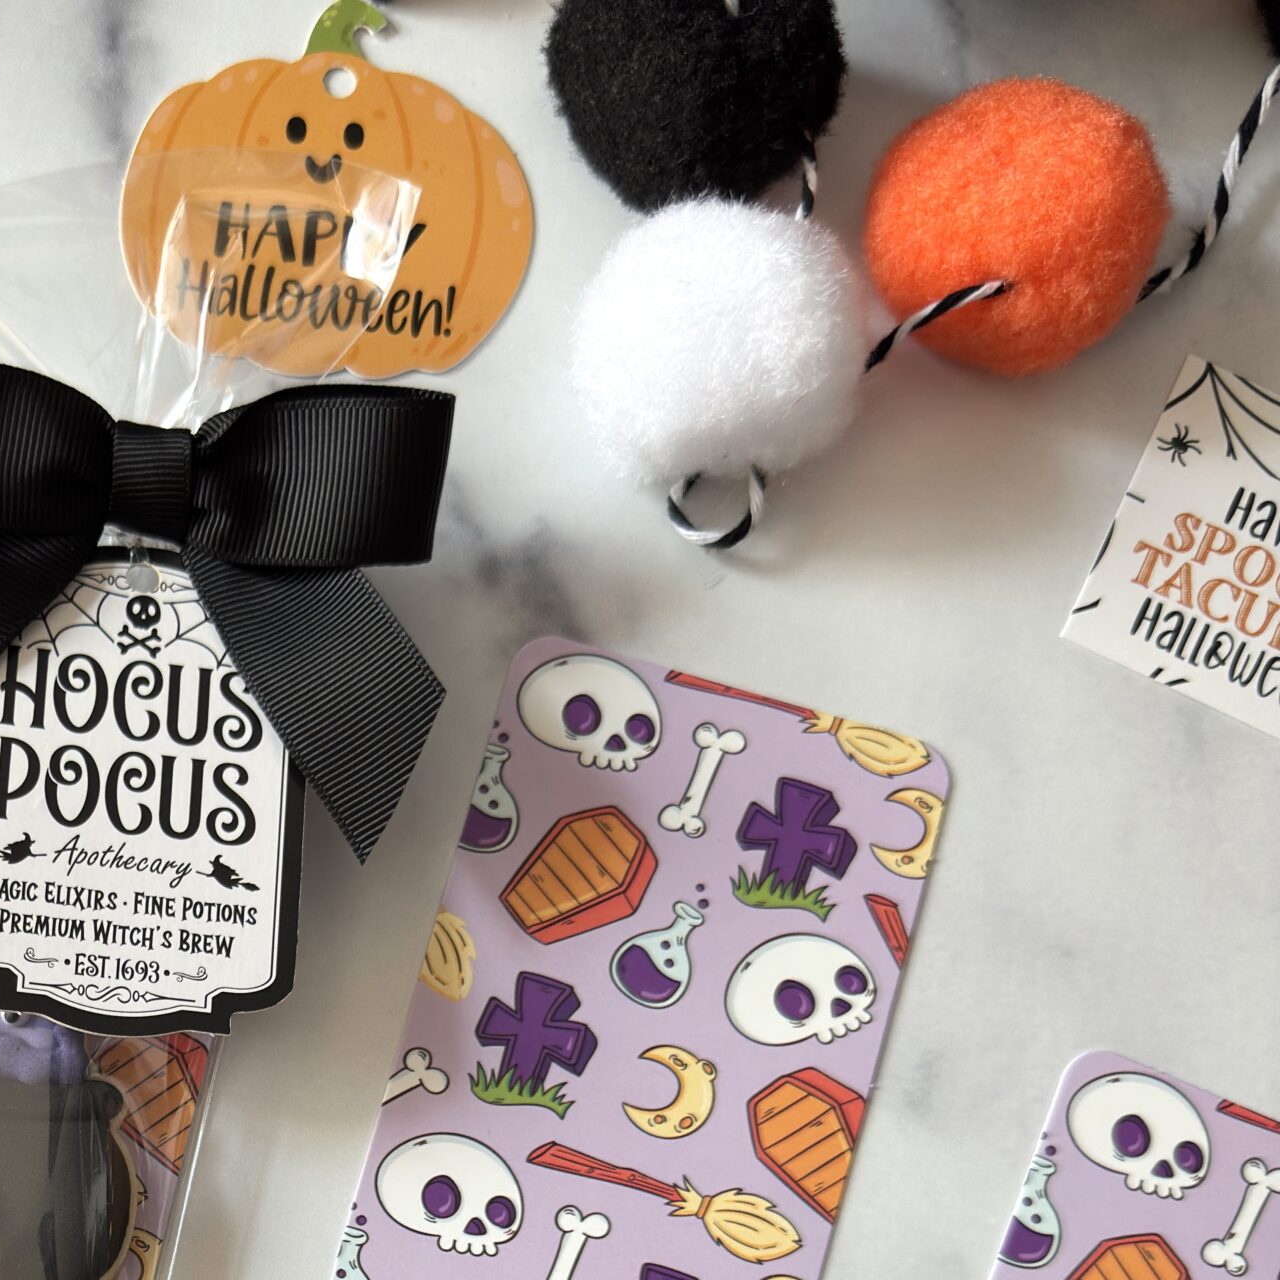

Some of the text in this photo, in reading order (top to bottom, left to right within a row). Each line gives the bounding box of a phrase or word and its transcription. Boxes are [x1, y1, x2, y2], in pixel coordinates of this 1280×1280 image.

[175, 258, 456, 338] Halloween!
[1224, 486, 1280, 547] Ha
[1164, 512, 1280, 602] SPO
[1130, 597, 1280, 705] Hallowe
[0, 645, 263, 751] HOCUS
[52, 834, 193, 888] Apothecary
[44, 882, 118, 911] ELIXIRS
[133, 892, 176, 921] FINE
[181, 896, 258, 928] POTIONS
[93, 919, 172, 951] WITCH'S
[178, 928, 236, 958] BREW
